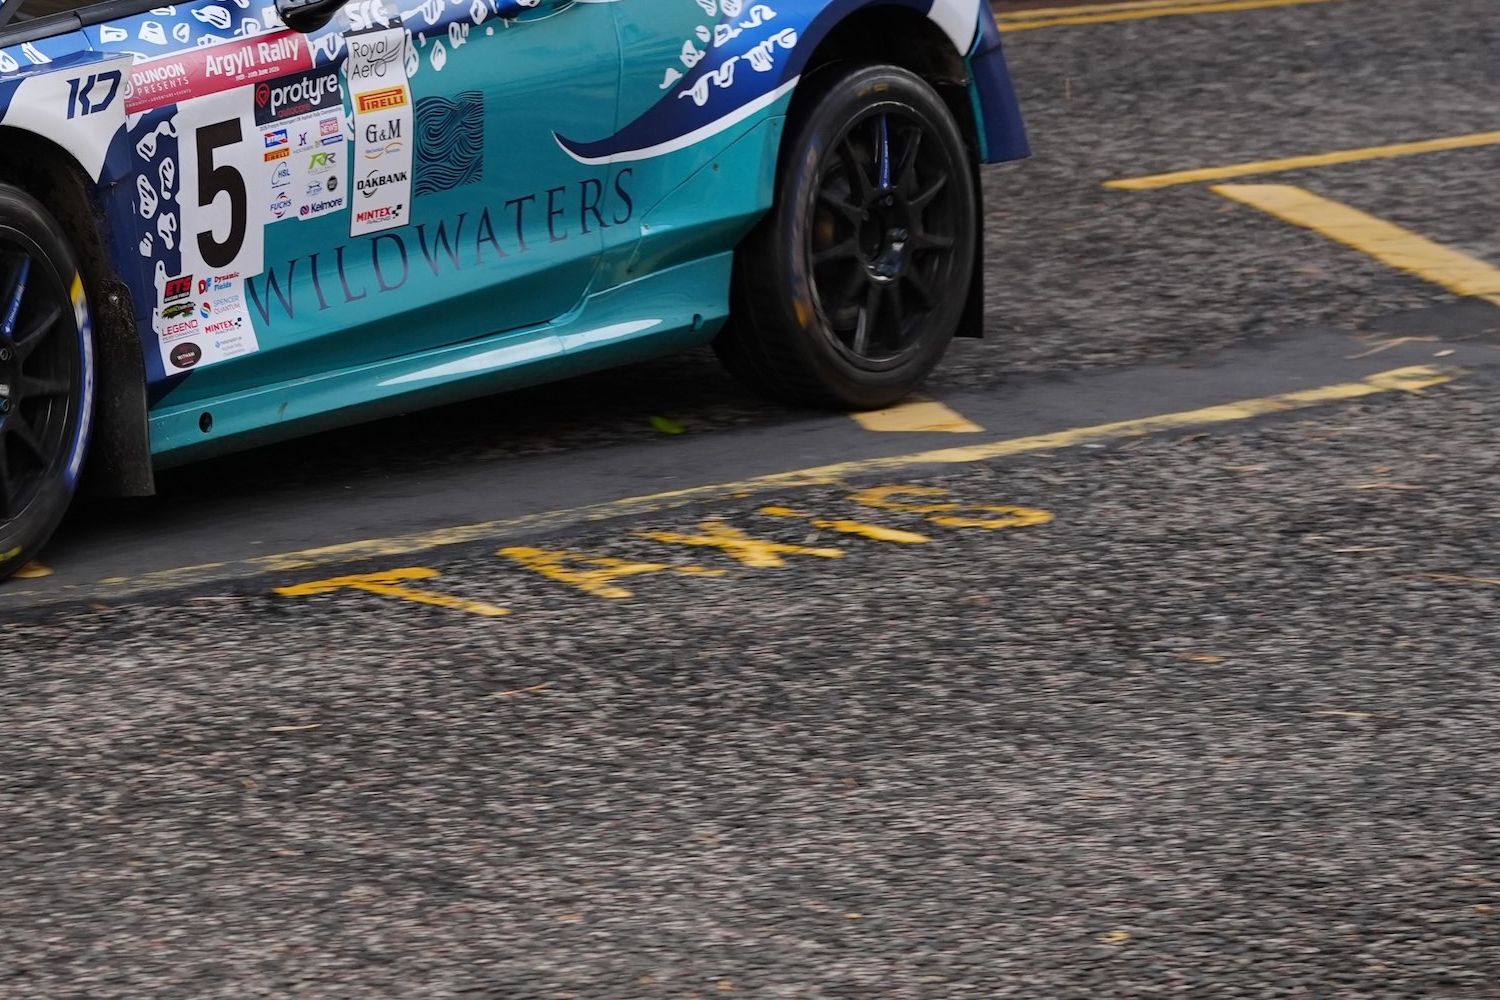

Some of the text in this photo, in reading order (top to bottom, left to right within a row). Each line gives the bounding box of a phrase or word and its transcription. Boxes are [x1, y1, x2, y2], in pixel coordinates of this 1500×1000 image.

[204, 36, 300, 79] Argyll Rally
[352, 36, 388, 60] Royal
[132, 62, 186, 87] DUNOON
[351, 59, 387, 81] Aero
[137, 76, 190, 97] PRESENTS
[270, 73, 338, 116] protyre
[358, 88, 404, 111] PIRELLI
[365, 118, 402, 144] G&M
[357, 171, 408, 191] OAKBANK
[195, 117, 248, 270] 5
[270, 198, 292, 212] FUCHS
[310, 198, 343, 214] Kelmore
[356, 206, 392, 223] MINTEX
[244, 167, 635, 328] WILDWATERS
[161, 319, 199, 337] LEGEND
[205, 320, 234, 334] MINTEX
[273, 484, 1058, 617] TAXIS
